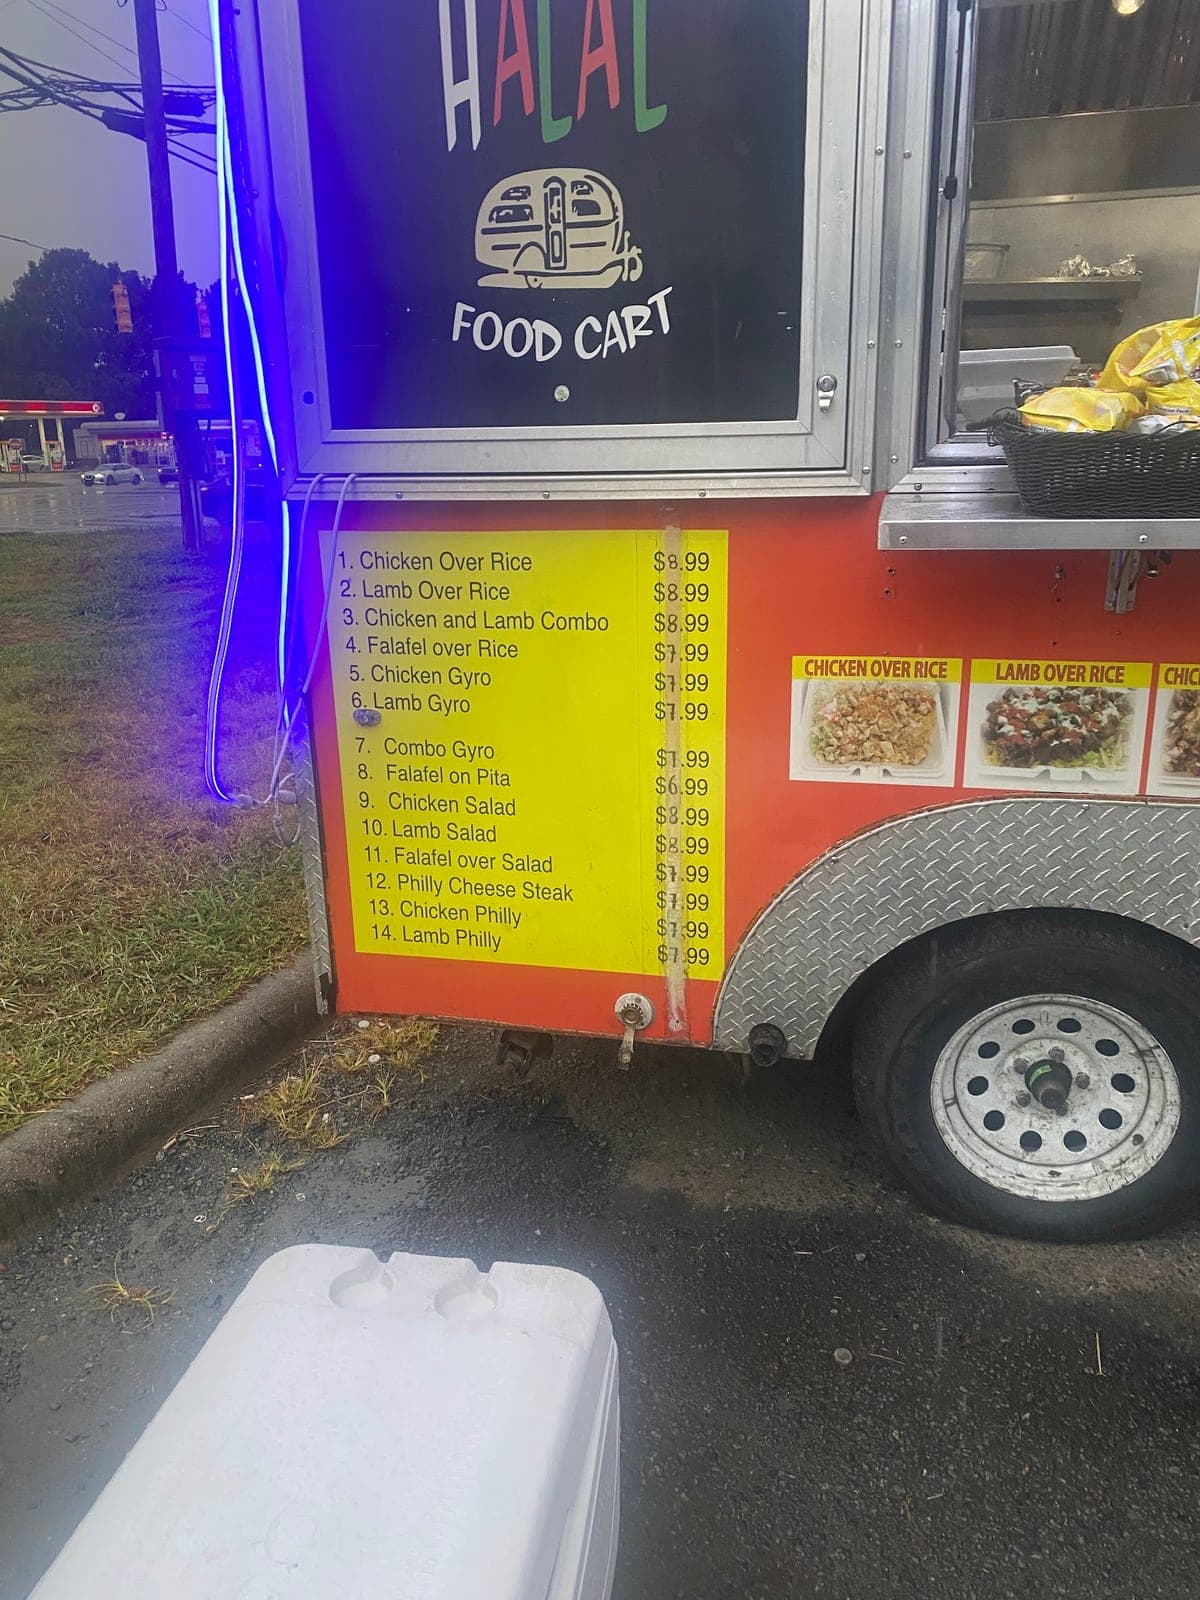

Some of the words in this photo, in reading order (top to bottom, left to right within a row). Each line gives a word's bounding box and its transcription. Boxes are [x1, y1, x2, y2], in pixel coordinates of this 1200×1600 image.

[439, 0, 668, 152] HALAL
[452, 302, 563, 362] FOOD
[574, 286, 673, 360] CART
[337, 552, 354, 569] 1.
[360, 551, 433, 571] Chicken
[439, 553, 483, 571] Over
[491, 553, 532, 572] Rice
[653, 552, 710, 573] $8.99
[340, 579, 356, 598] 2.
[363, 580, 412, 599] Lamb
[418, 582, 463, 600] Over
[469, 583, 510, 601] Rice
[653, 582, 709, 604] $8.99
[343, 608, 359, 626] 3.
[365, 608, 437, 628] Chicken
[443, 611, 476, 629] and
[483, 611, 534, 630] Lamb
[541, 612, 609, 631] Combo
[654, 612, 709, 634] $8.99
[345, 637, 361, 653] 4.
[368, 636, 428, 656] Falafel
[433, 643, 472, 657] over
[478, 640, 519, 658] Rice
[654, 642, 709, 663] $7.99
[349, 665, 365, 682] 5.
[371, 665, 442, 684] Chicken
[448, 667, 492, 691] Gyro
[805, 659, 867, 677] CHICKEN
[871, 660, 910, 677] OVER
[915, 661, 948, 678] RICE
[996, 663, 1040, 681] LAMB
[1043, 664, 1085, 682] OVER
[1090, 665, 1125, 683] RICE
[1164, 667, 1200, 686] CHIC
[351, 692, 368, 709] 6.
[373, 694, 422, 711] Lamb
[428, 696, 471, 719] Gyro
[355, 738, 371, 754] 7.
[384, 738, 446, 757] Combo
[452, 741, 495, 763] Gyro
[358, 764, 372, 780] 8.
[386, 764, 443, 783] Falafel
[449, 771, 470, 785] on
[478, 769, 511, 787] Pita
[656, 775, 708, 797] $6.99
[359, 792, 374, 809] 9.
[388, 792, 459, 812] Chicken
[465, 796, 516, 816] Salad
[656, 806, 709, 826] $8.99
[362, 819, 387, 836] 10.
[392, 821, 441, 839] Lamb
[447, 823, 496, 842] Salad
[656, 834, 709, 854] $8.99
[364, 846, 388, 863] 11.
[395, 847, 451, 866] Falafel
[458, 855, 496, 869] over
[502, 853, 552, 872] Salad
[366, 873, 391, 889] 12.
[398, 873, 442, 896] Philly
[449, 877, 516, 898] Cheese
[522, 883, 574, 901] Steak
[369, 900, 394, 916] 13.
[400, 901, 469, 921] Chicken
[476, 906, 521, 929] Philly
[372, 925, 396, 941] 14.
[403, 926, 450, 944] Lamb
[456, 929, 501, 952] Philly
